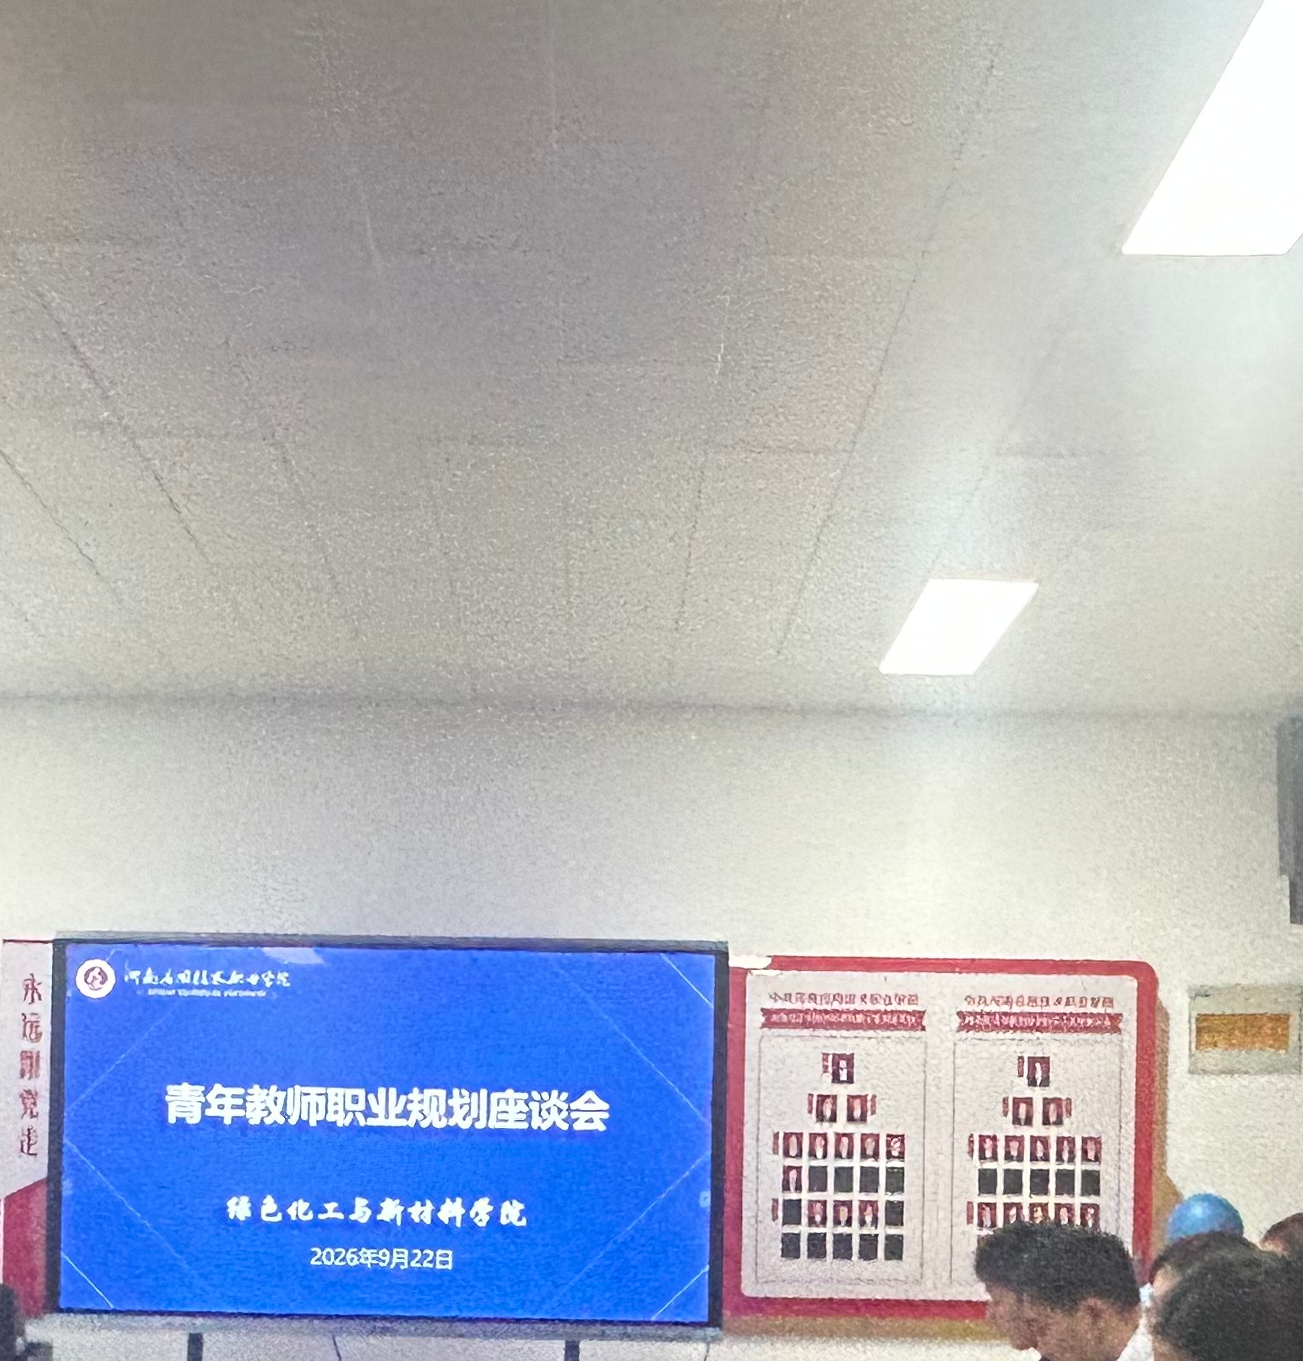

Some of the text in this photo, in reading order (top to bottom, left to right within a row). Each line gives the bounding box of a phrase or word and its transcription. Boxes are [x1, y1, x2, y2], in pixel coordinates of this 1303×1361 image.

[165, 1083, 610, 1132] 青年教师职业规划座谈会
[226, 1195, 528, 1227] 绿色化工与新材料学院
[309, 1247, 454, 1271] 2026年9月22日
